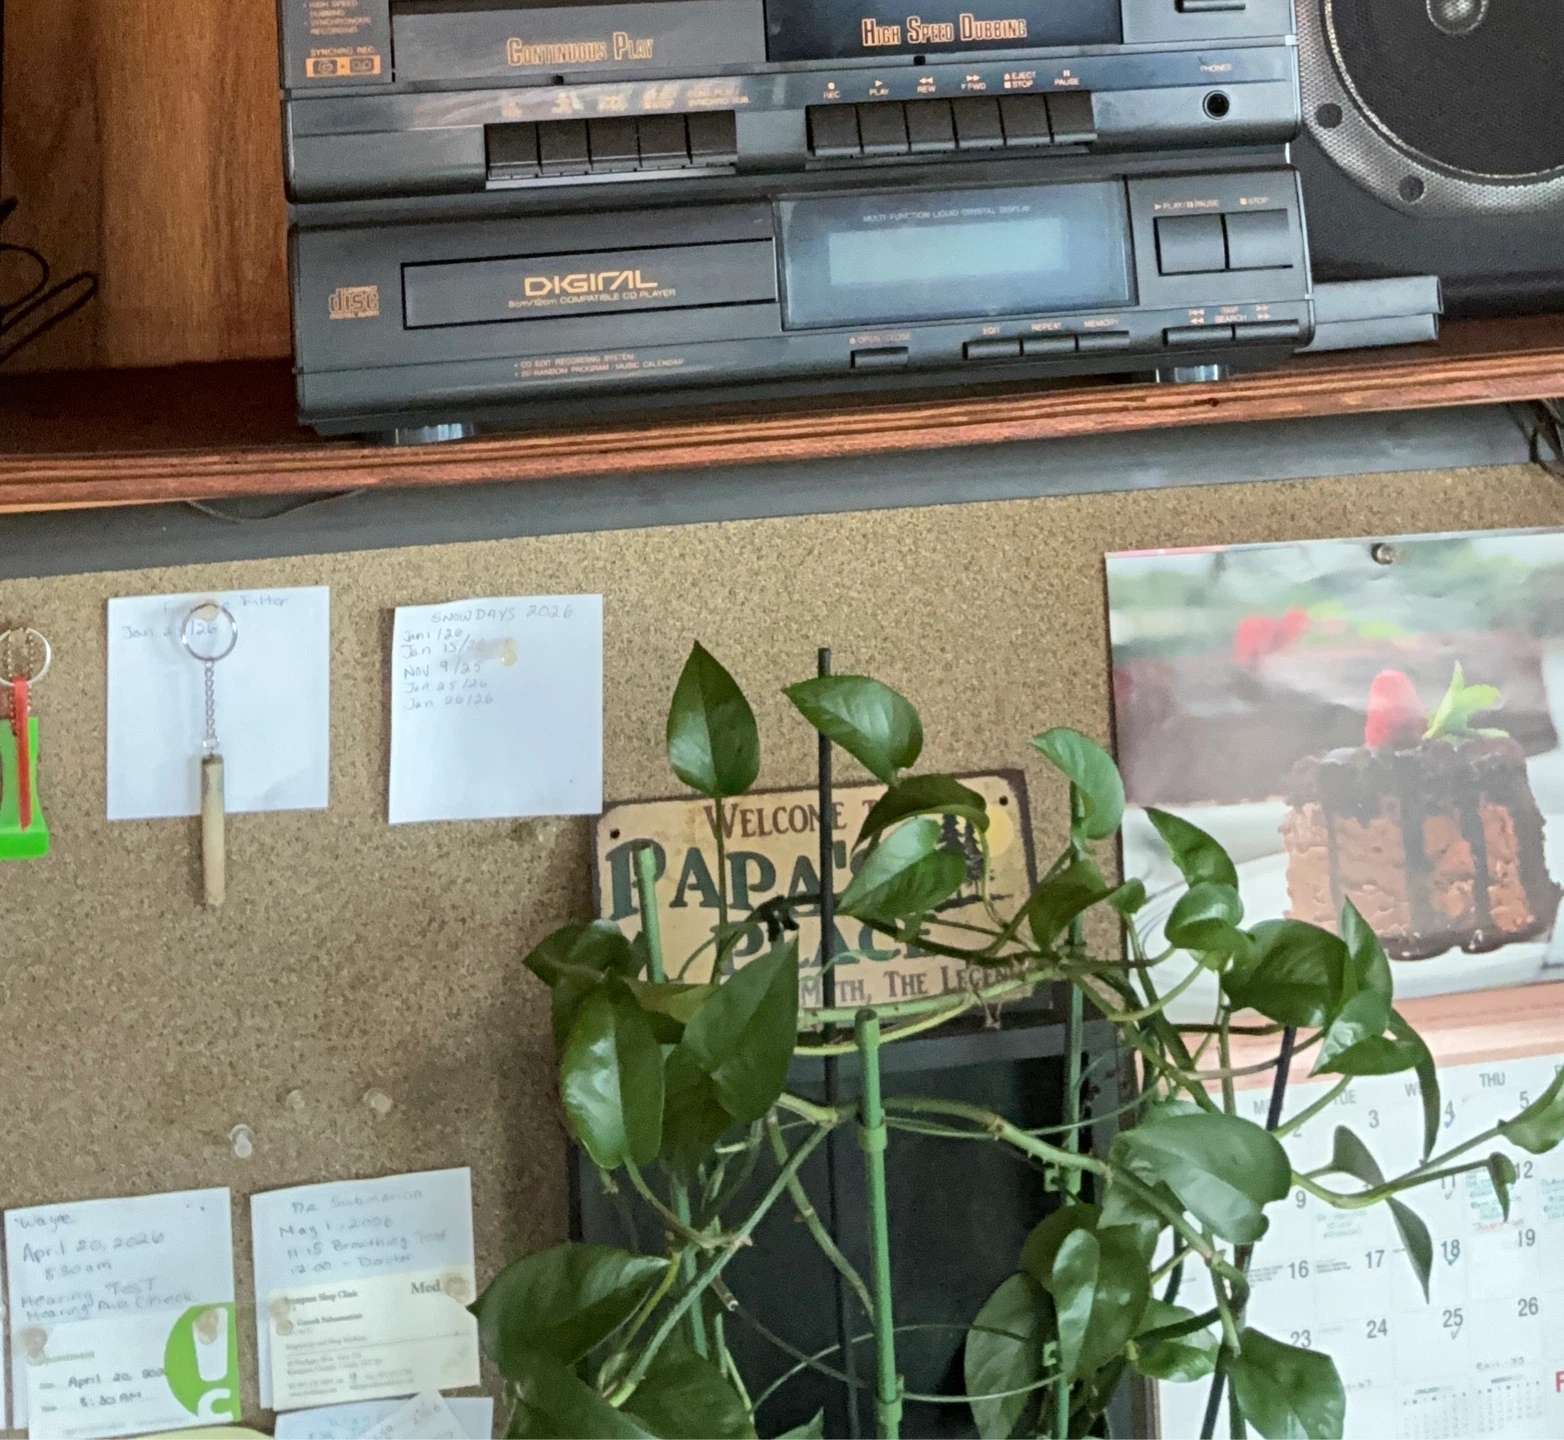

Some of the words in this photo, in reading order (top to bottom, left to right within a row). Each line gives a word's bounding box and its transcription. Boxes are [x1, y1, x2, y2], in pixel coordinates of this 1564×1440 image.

[862, 18, 901, 47] HIGH
[907, 15, 954, 44] SPEED
[959, 13, 1028, 41] DUBBING
[507, 37, 608, 67] CONTINUOUS
[613, 31, 654, 60] PLAY
[1011, 71, 1036, 80] EJECT
[823, 91, 840, 100] REC
[869, 88, 889, 97] PLAY
[917, 85, 936, 94] REW
[1012, 80, 1034, 89] STOP
[1054, 77, 1080, 86] PAUSE
[890, 211, 930, 221] FUNCTION
[933, 210, 959, 219] LIQUID
[524, 270, 659, 297] DIGITAL
[328, 289, 379, 312] disc
[560, 293, 620, 305] COMPATIBLE
[623, 291, 637, 300] CD
[639, 288, 677, 298] PLAYER
[1031, 322, 1062, 331] REPEAT
[1083, 319, 1119, 328] MEMORY
[1214, 314, 1247, 323] SEARCH
[533, 367, 568, 376] RANDOM
[571, 364, 610, 374] PROGRAM
[615, 361, 640, 370] MUSIC
[526, 604, 573, 618] 2026
[121, 625, 154, 639] Jan
[401, 644, 432, 659] Jan
[404, 682, 429, 694] Jan
[404, 698, 434, 710] Jan
[884, 970, 928, 998] THE
[1479, 1072, 1506, 1088] THU
[1368, 1109, 1379, 1129] 3
[1519, 1090, 1530, 1109] 5
[1295, 1190, 1306, 1209] 9
[1516, 1160, 1534, 1180] 12
[14, 1213, 76, 1232] Wayne
[279, 1224, 318, 1240] May
[23, 1240, 66, 1264] April
[113, 1232, 165, 1250] 2026
[1288, 1260, 1310, 1279] 16
[1365, 1249, 1385, 1269] 17
[1441, 1239, 1461, 1259] 18
[1517, 1228, 1536, 1248] 19
[411, 1279, 441, 1294] Med
[1290, 1329, 1312, 1348] 23
[1366, 1318, 1388, 1339] 24
[1442, 1307, 1464, 1328] 25
[1517, 1296, 1539, 1317] 26
[68, 1373, 101, 1389] April
[119, 1391, 142, 1404] AM
